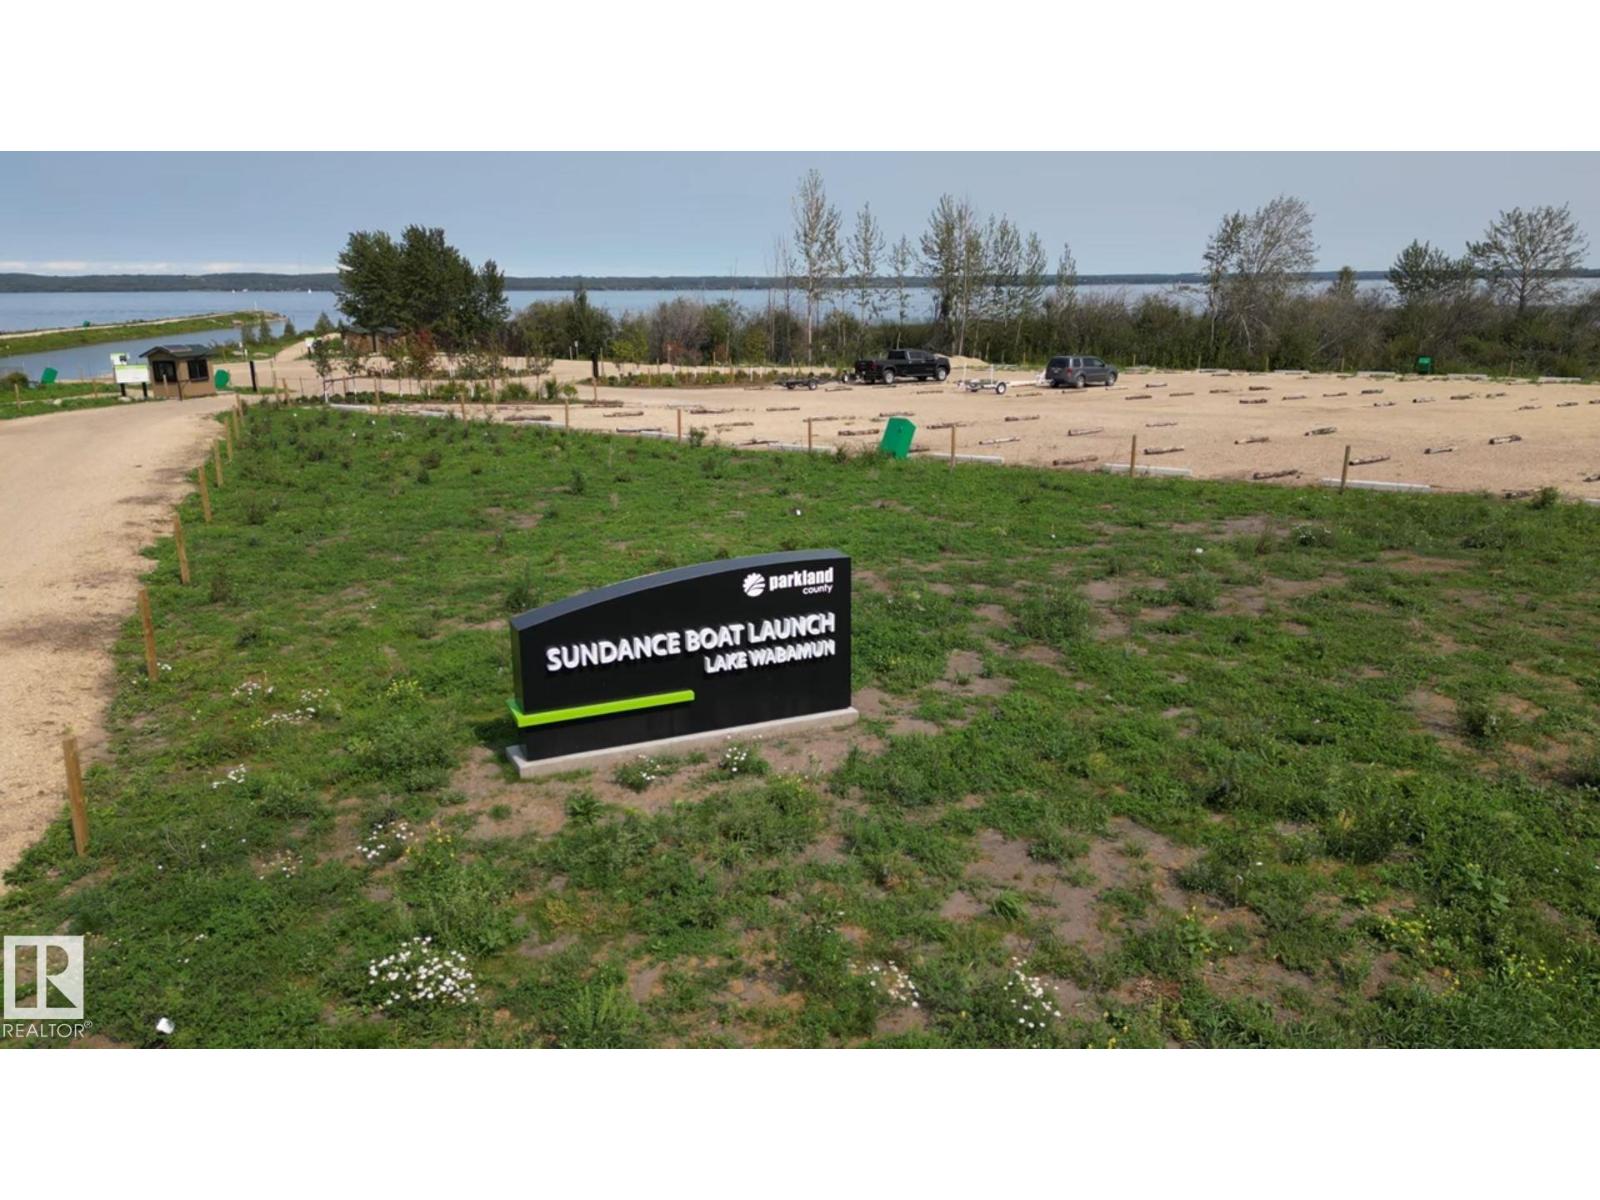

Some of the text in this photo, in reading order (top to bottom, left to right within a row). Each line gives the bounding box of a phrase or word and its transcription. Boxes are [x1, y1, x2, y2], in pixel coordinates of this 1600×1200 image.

[769, 567, 835, 590] parkland
[803, 584, 834, 596] county
[546, 612, 836, 671] SUNDANCE BOAT LAUNCH
[704, 639, 836, 674] LAKE WABAMUN
